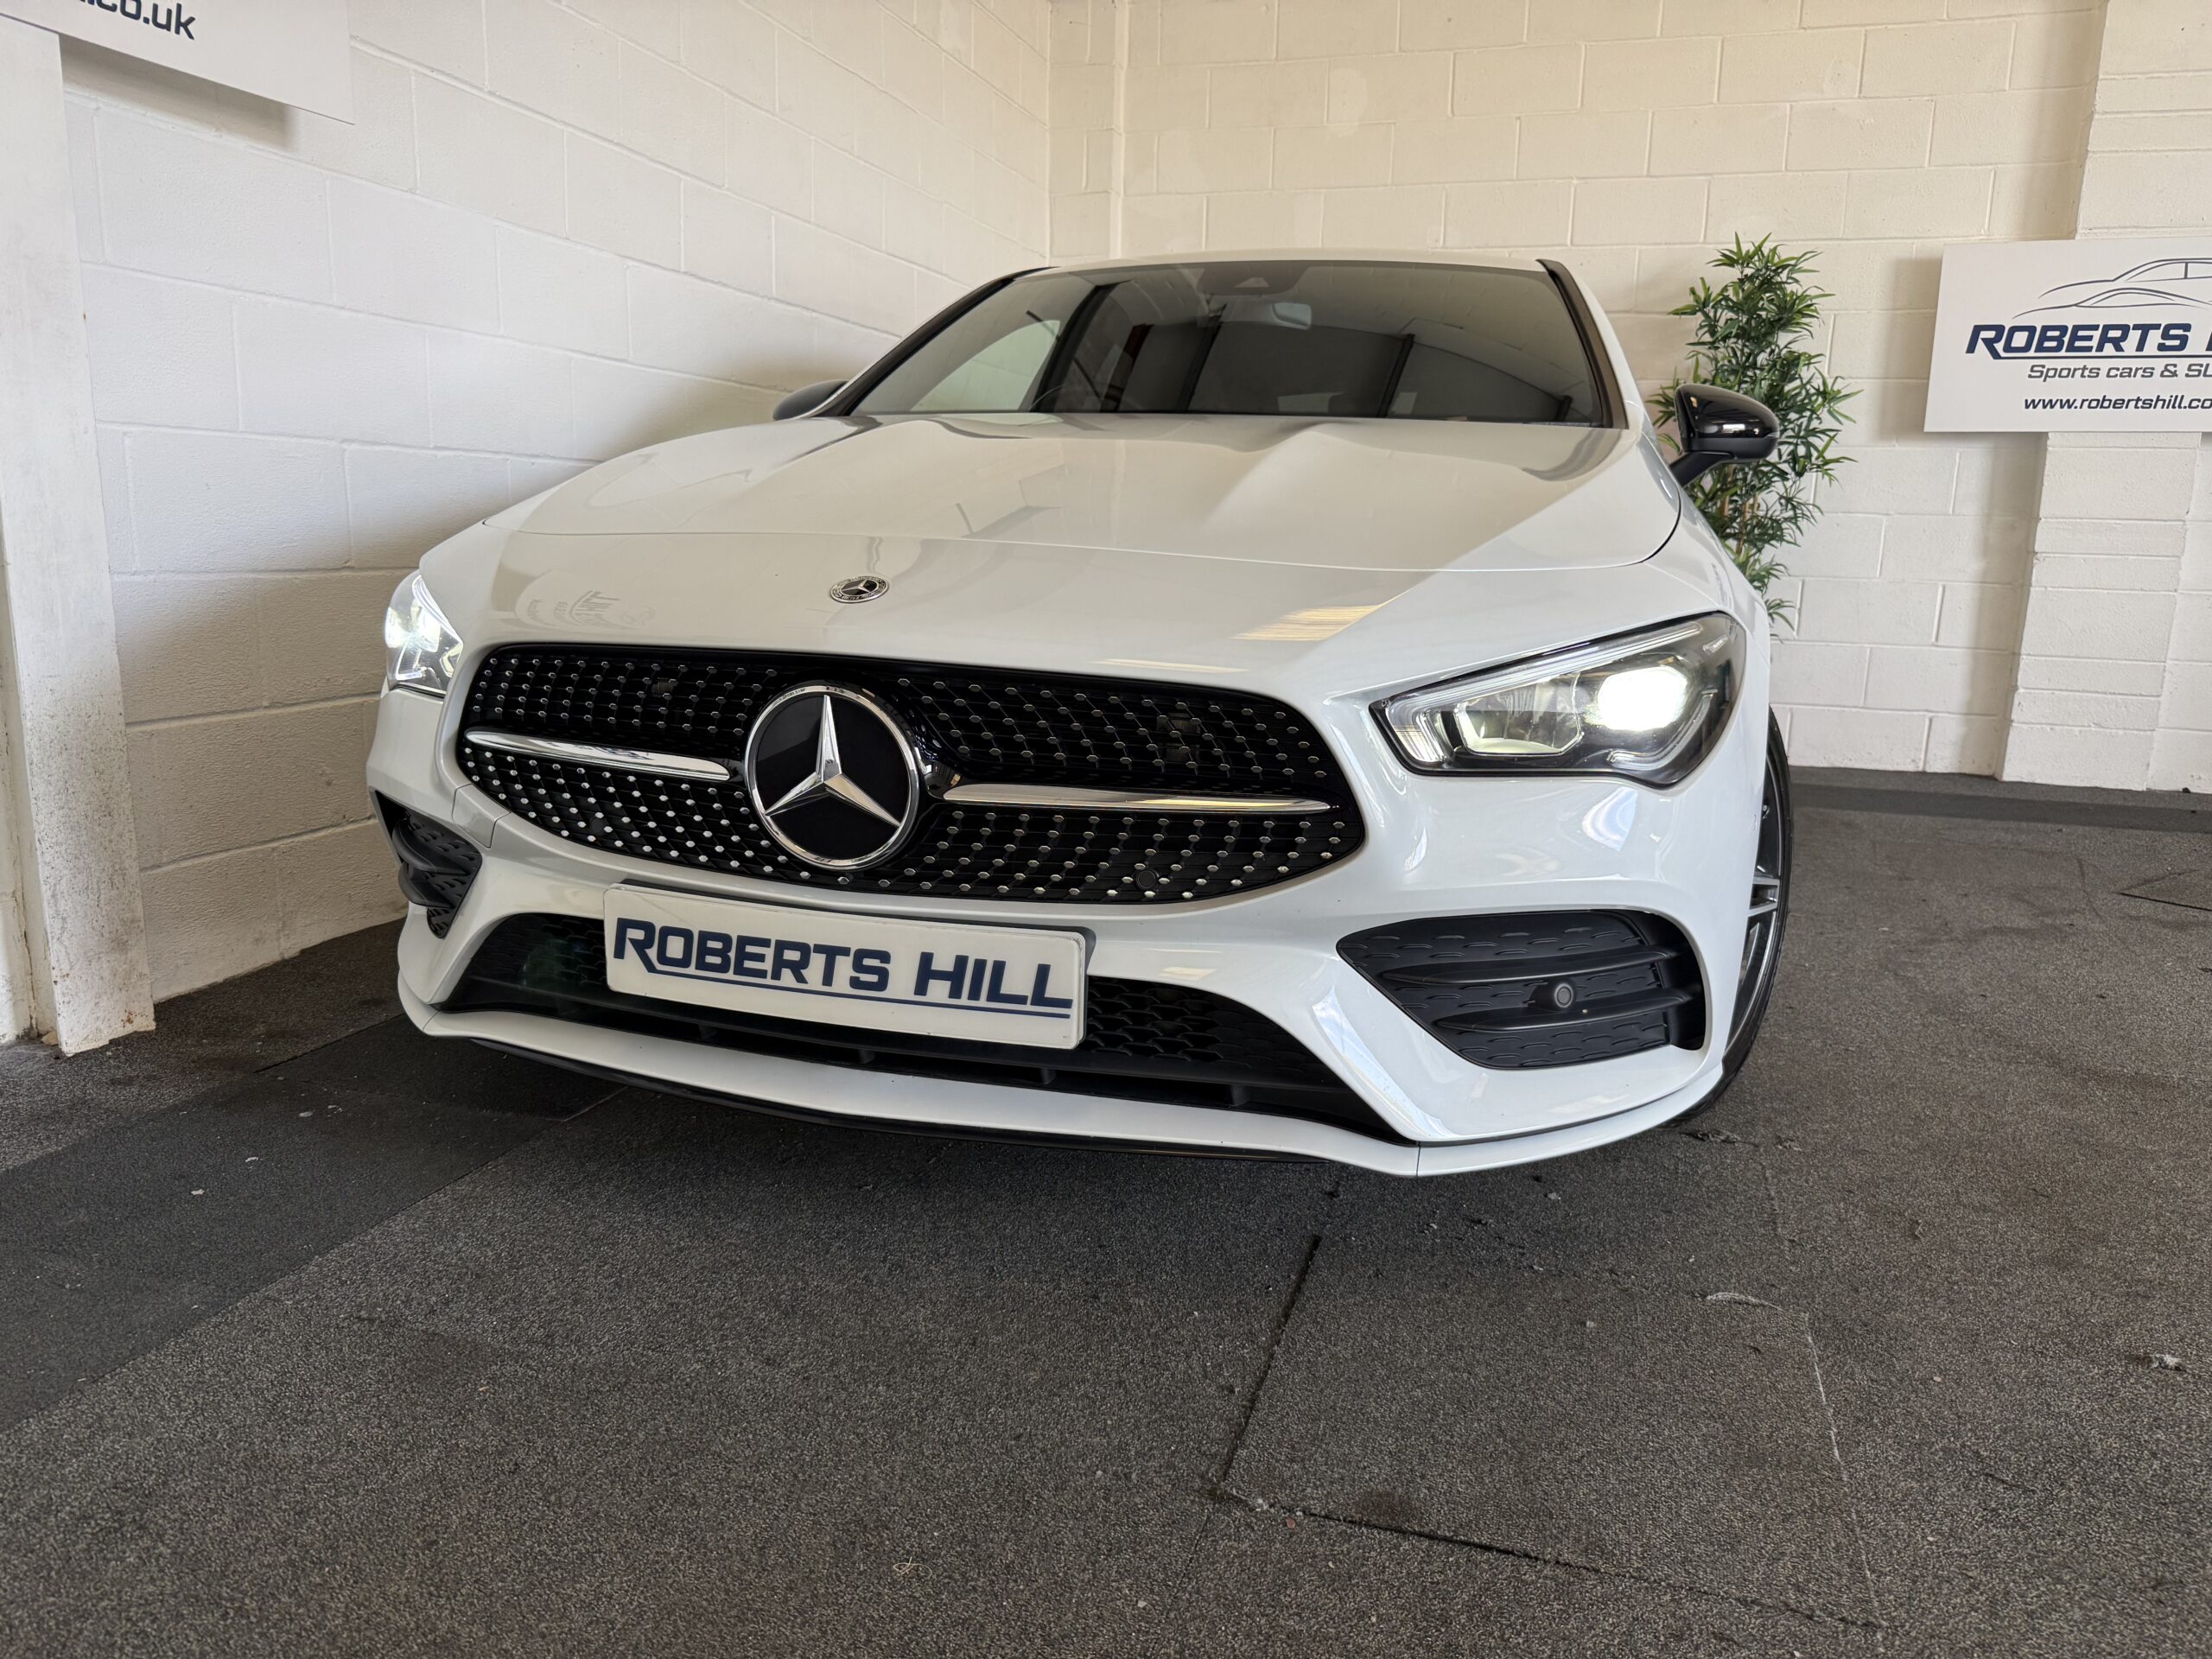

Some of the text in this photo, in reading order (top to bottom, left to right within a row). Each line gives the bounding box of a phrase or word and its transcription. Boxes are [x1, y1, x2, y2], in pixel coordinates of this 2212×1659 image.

[1965, 323, 2192, 359] ROBERTS
[2028, 364, 2101, 382] Sports
[2106, 366, 2155, 378] cars
[2159, 363, 2178, 378] &
[613, 917, 1074, 1009] ROBERTS HILL
